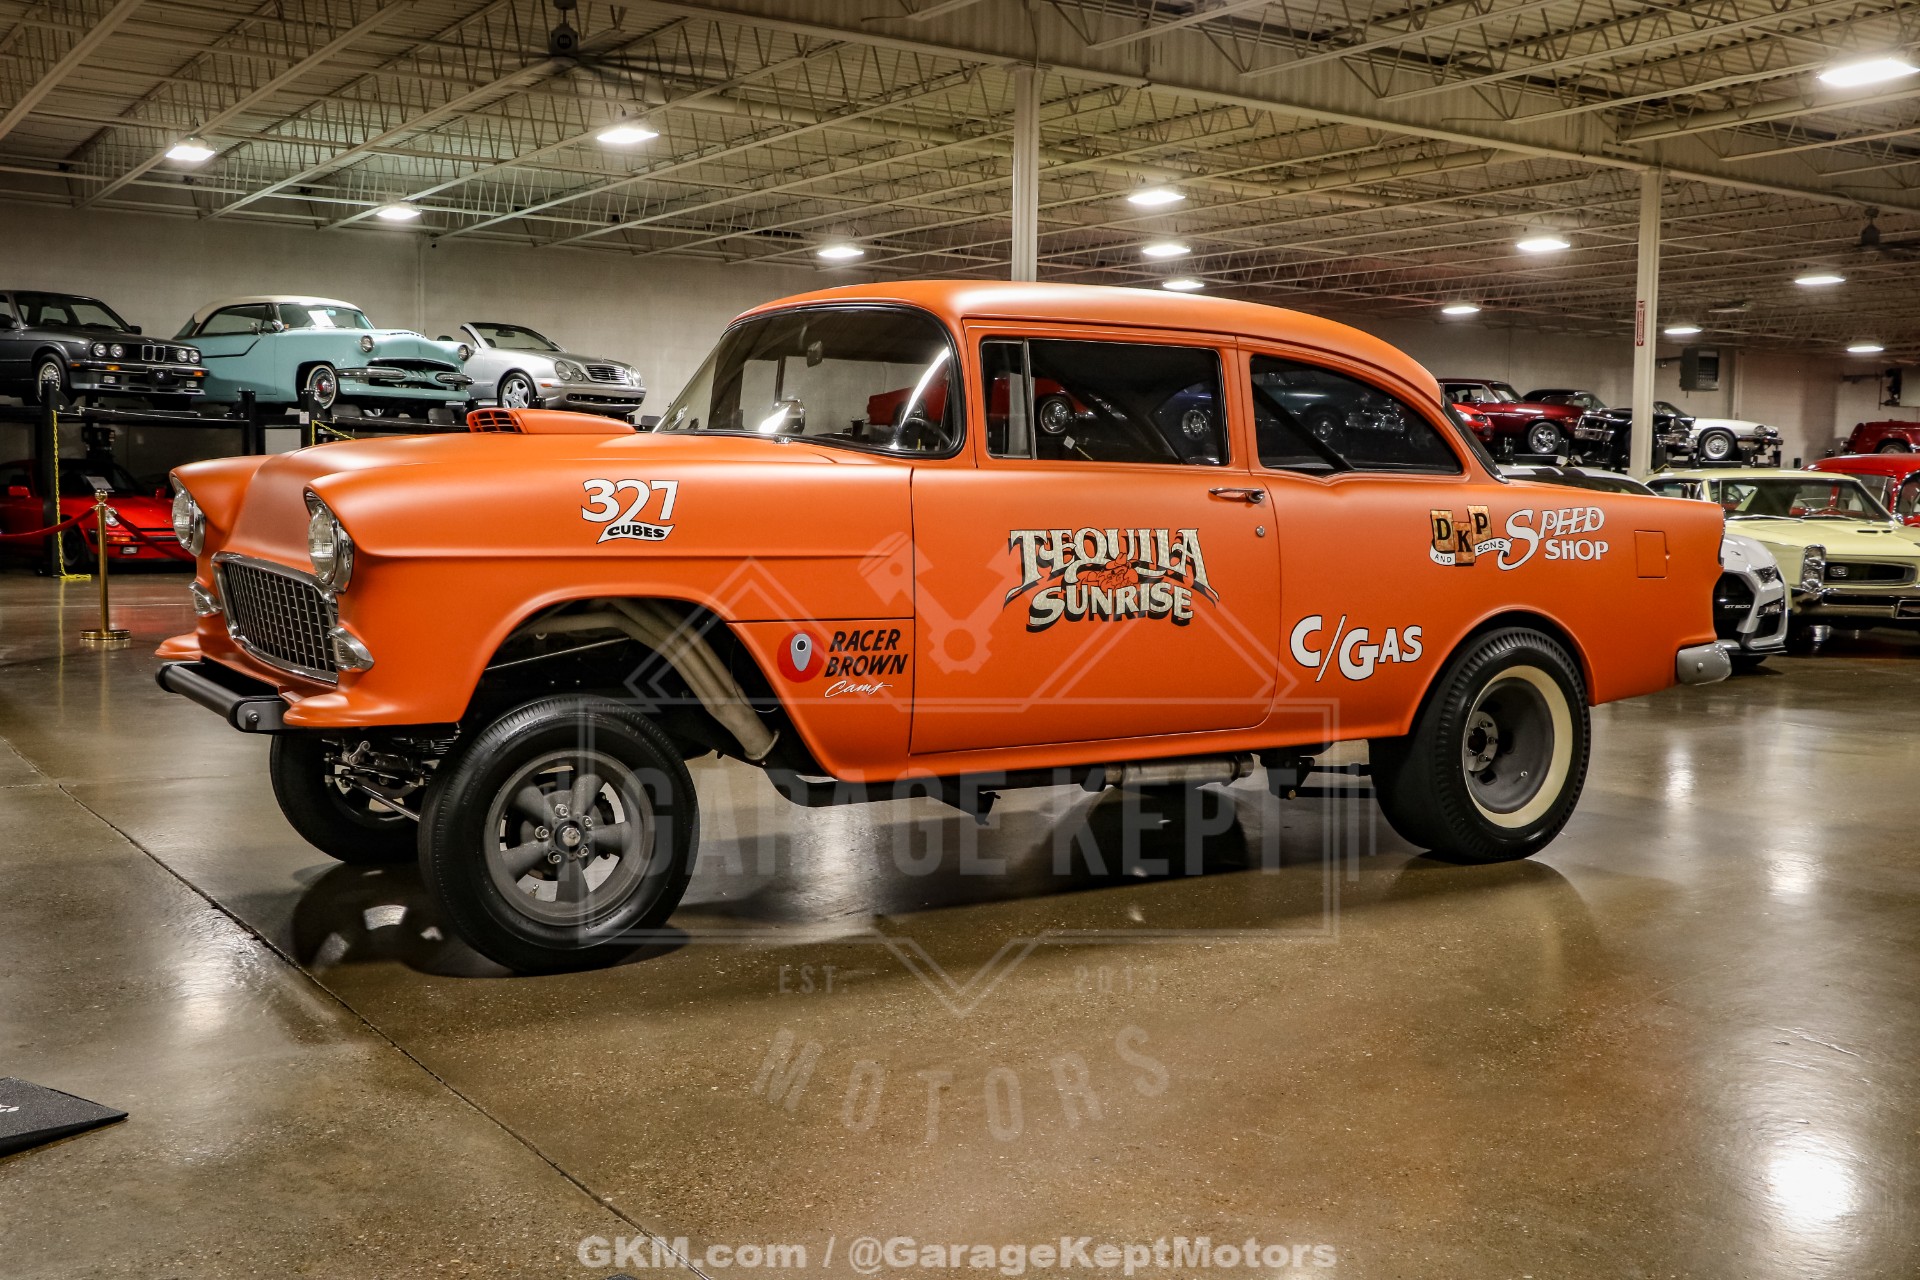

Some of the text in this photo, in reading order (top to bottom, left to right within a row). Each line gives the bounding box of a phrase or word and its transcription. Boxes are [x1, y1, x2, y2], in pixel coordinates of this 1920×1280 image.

[581, 478, 679, 540] 327
[606, 524, 666, 538] CUBES
[1497, 506, 1606, 571] SPEED
[1477, 540, 1505, 552] SONS
[1544, 539, 1609, 560] SHOP
[1003, 527, 1220, 607] TEQUILA
[1434, 554, 1452, 564] AND
[1027, 582, 1195, 632] SUNRISE
[828, 629, 901, 652] RACER
[1289, 614, 1424, 682] C/GAS
[824, 653, 909, 677] BROWN
